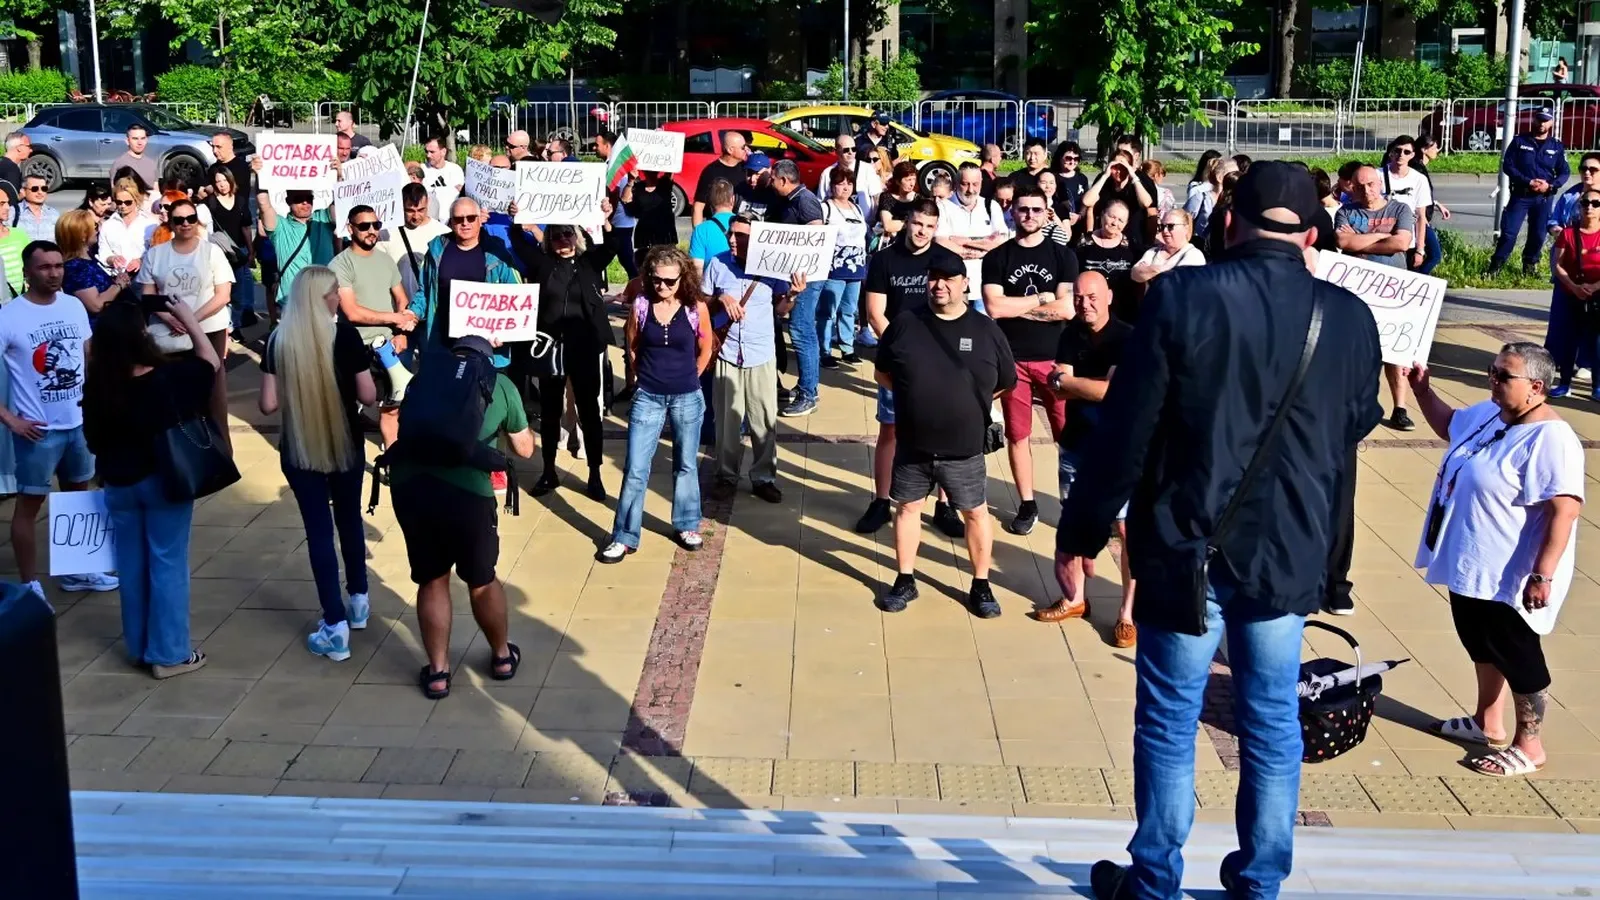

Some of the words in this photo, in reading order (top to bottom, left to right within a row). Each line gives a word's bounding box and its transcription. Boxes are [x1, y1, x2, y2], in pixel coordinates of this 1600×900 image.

[261, 144, 333, 161] ОСТАВКА
[271, 164, 318, 179] КОЦЕВ
[475, 182, 498, 200] ГРАД
[757, 229, 826, 248] ОСТАВКА
[1008, 263, 1053, 285] MONCLER
[1326, 261, 1431, 309] ОСТАВКА
[455, 291, 532, 312] ОСТАВКА
[466, 315, 517, 334] КОЦЕВ
[53, 511, 117, 555] ОСТА
